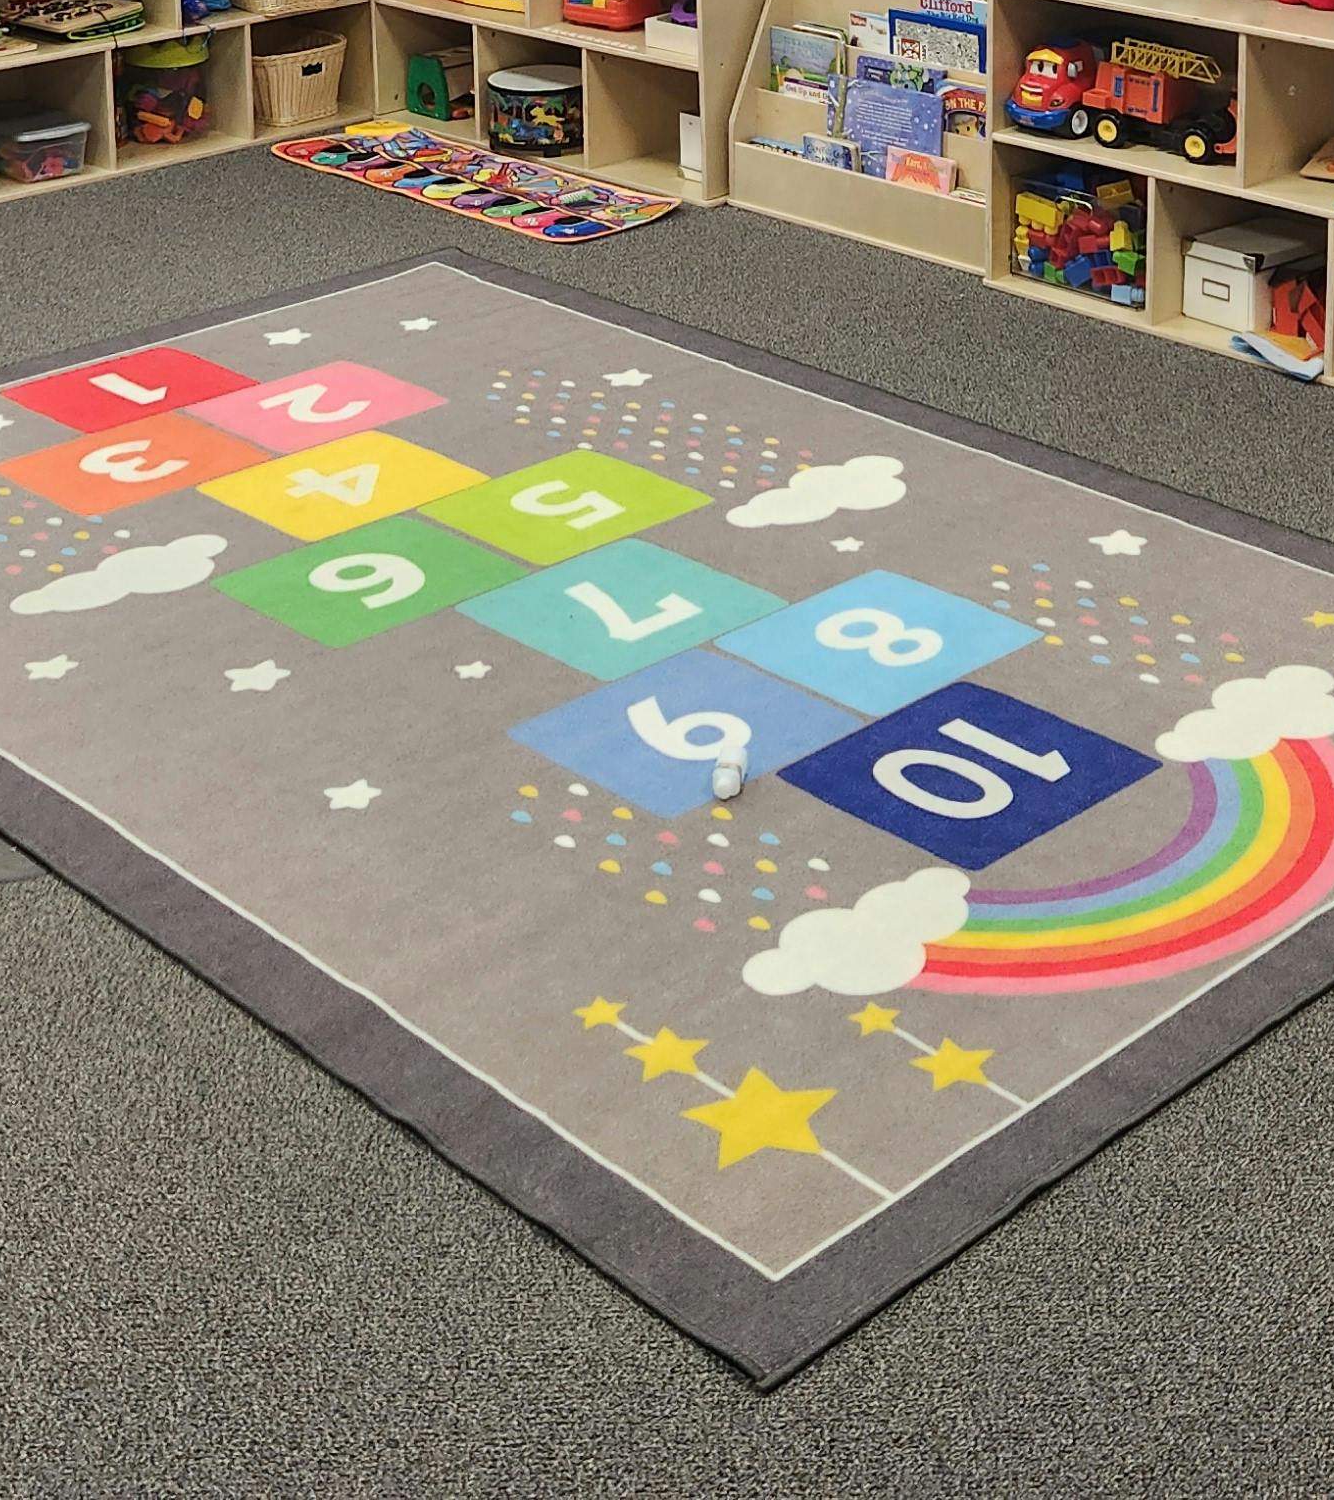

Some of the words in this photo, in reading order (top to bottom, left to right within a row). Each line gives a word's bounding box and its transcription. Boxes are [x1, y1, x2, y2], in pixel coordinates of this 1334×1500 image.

[957, 97, 977, 110] THE
[89, 372, 167, 405] 1
[259, 383, 372, 424] 2
[78, 440, 190, 483] 3
[284, 463, 381, 506] 4
[509, 480, 626, 530] 5
[308, 552, 427, 609] 6
[564, 581, 704, 643] 7
[814, 608, 944, 667] 8
[627, 696, 753, 762] 9
[872, 717, 1071, 820] 10
